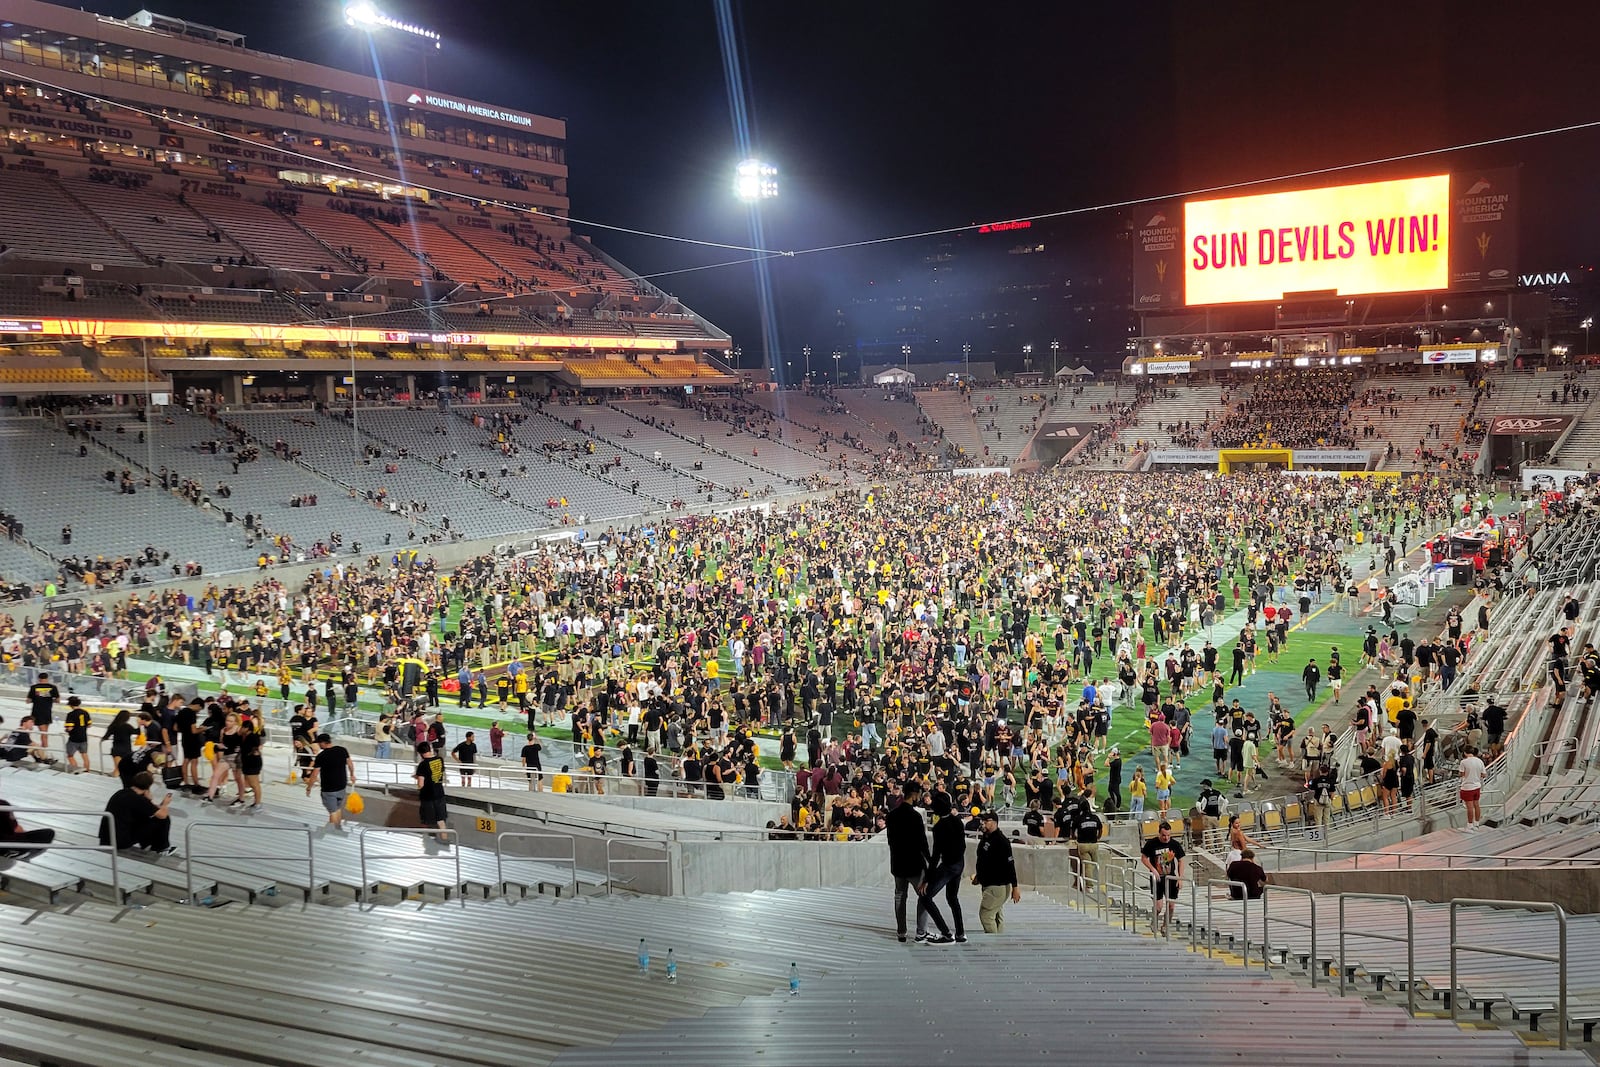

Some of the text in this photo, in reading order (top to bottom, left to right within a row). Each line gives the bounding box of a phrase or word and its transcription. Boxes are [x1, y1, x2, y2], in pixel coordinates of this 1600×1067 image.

[425, 95, 532, 127] MOUNTAIN AMERICA STADIUM
[8, 111, 133, 139] FRANK KUSH FIELD
[208, 143, 241, 156] HOME
[243, 149, 258, 159] OF
[260, 151, 281, 162] THE
[282, 155, 303, 167] ASU
[181, 180, 200, 193] 27
[1455, 194, 1509, 206] MOUNTAIN
[1459, 203, 1505, 214] AMERICA
[1140, 227, 1179, 237] MOUNTAIN
[1142, 235, 1177, 244] AMERICA
[1193, 213, 1438, 270] SUN DEVILS WIN!
[1500, 420, 1537, 428] AAA
[480, 819, 491, 831] 38
[1309, 830, 1320, 840] 35
